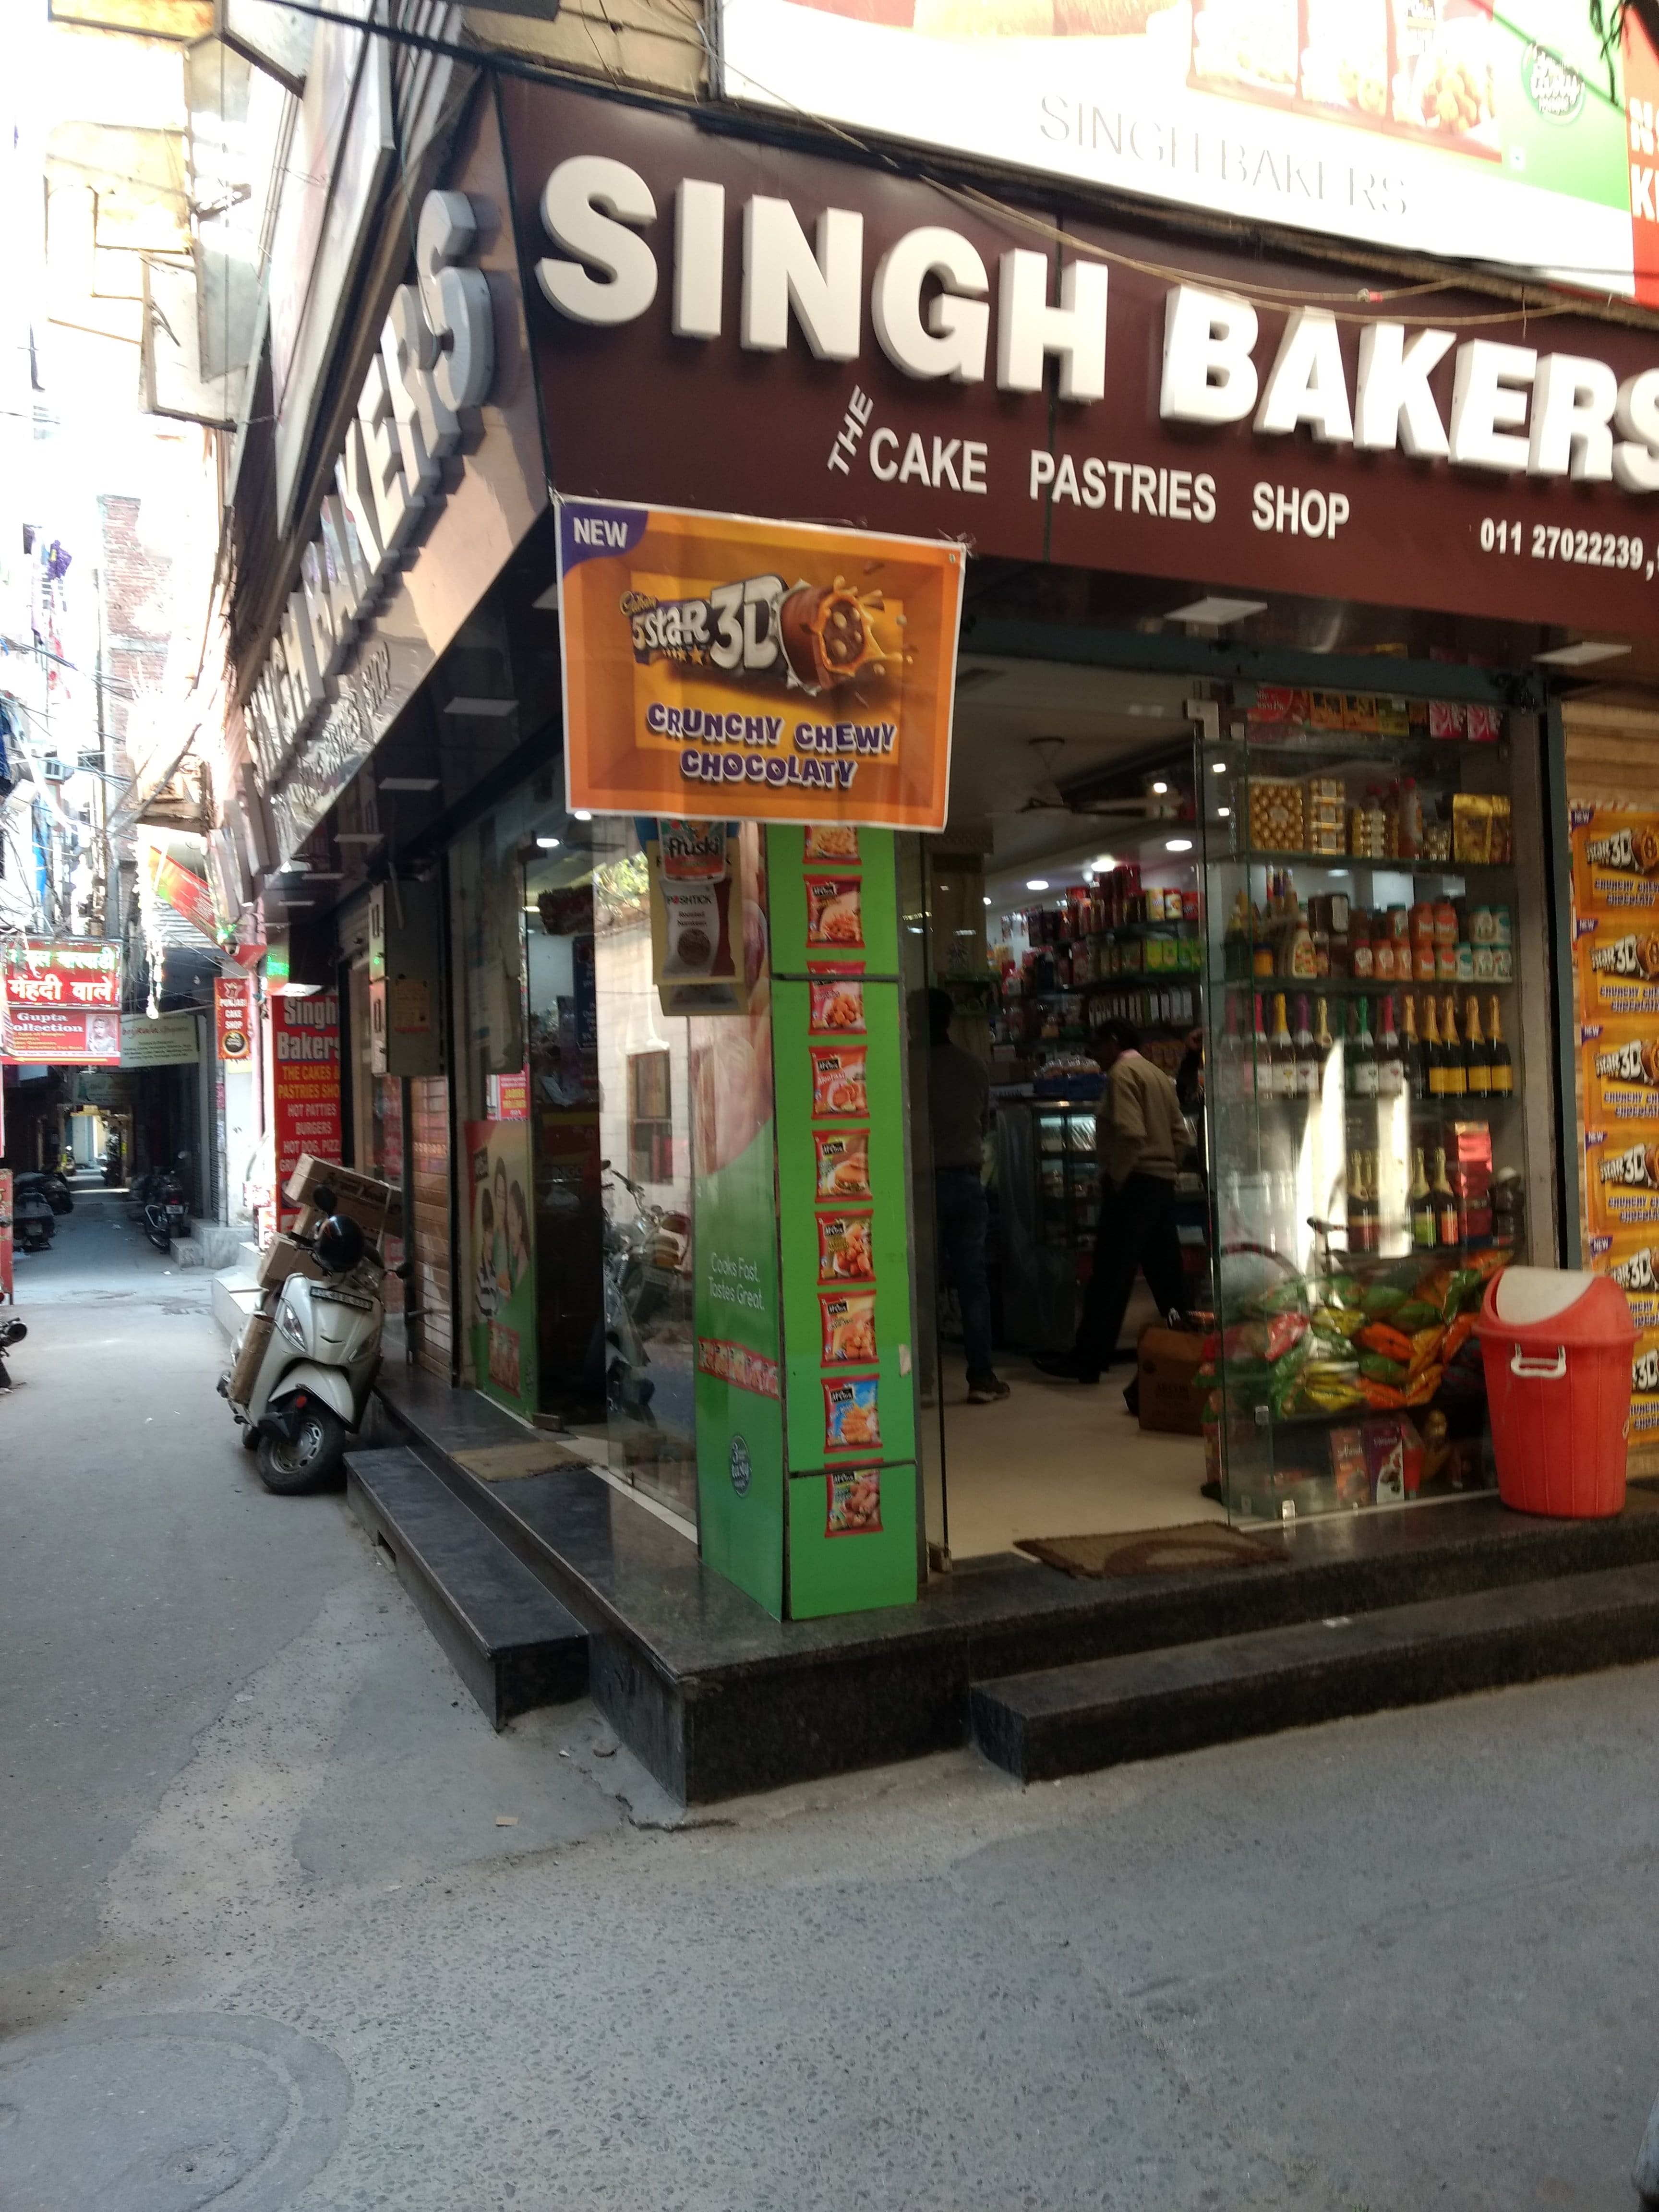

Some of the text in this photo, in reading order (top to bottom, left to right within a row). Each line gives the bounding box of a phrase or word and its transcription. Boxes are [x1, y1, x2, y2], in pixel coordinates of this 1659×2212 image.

[534, 155, 1108, 406] SINGH
[827, 385, 873, 475] THE
[869, 426, 1351, 539] CAKE PASTRIES SHOP
[573, 517, 628, 548] NEW
[1480, 517, 1522, 555] 011
[710, 576, 781, 669] 3D
[648, 703, 897, 754] CRUNCHY CHEWY
[681, 749, 858, 789] CHOCOLATY
[1575, 810, 1589, 823] NEW
[1611, 827, 1632, 866] 3D
[1579, 919, 1594, 931] NEW
[1615, 933, 1636, 973] 3D
[70, 975, 113, 1001] वाले
[16, 1012, 68, 1023] Gupta
[283, 997, 336, 1029] Singh
[1585, 1025, 1599, 1037] NEW
[282, 1066, 300, 1080] THE
[301, 1066, 331, 1080] CAKES
[1620, 1039, 1642, 1079] 3D
[278, 1084, 319, 1099] PASTRIES
[288, 1104, 336, 1117] HOT PATTIES
[295, 1122, 332, 1135] BURGERS
[1588, 1131, 1603, 1142] NEW
[283, 1141, 300, 1154] HOT
[1624, 1143, 1646, 1184] 3D
[1594, 1237, 1608, 1251] NEW
[710, 1252, 760, 1282] Cooks Fast.
[1629, 1248, 1651, 1289] 3D
[708, 1276, 765, 1310] Tastes Great.
[1636, 1349, 1658, 1390] 3D
